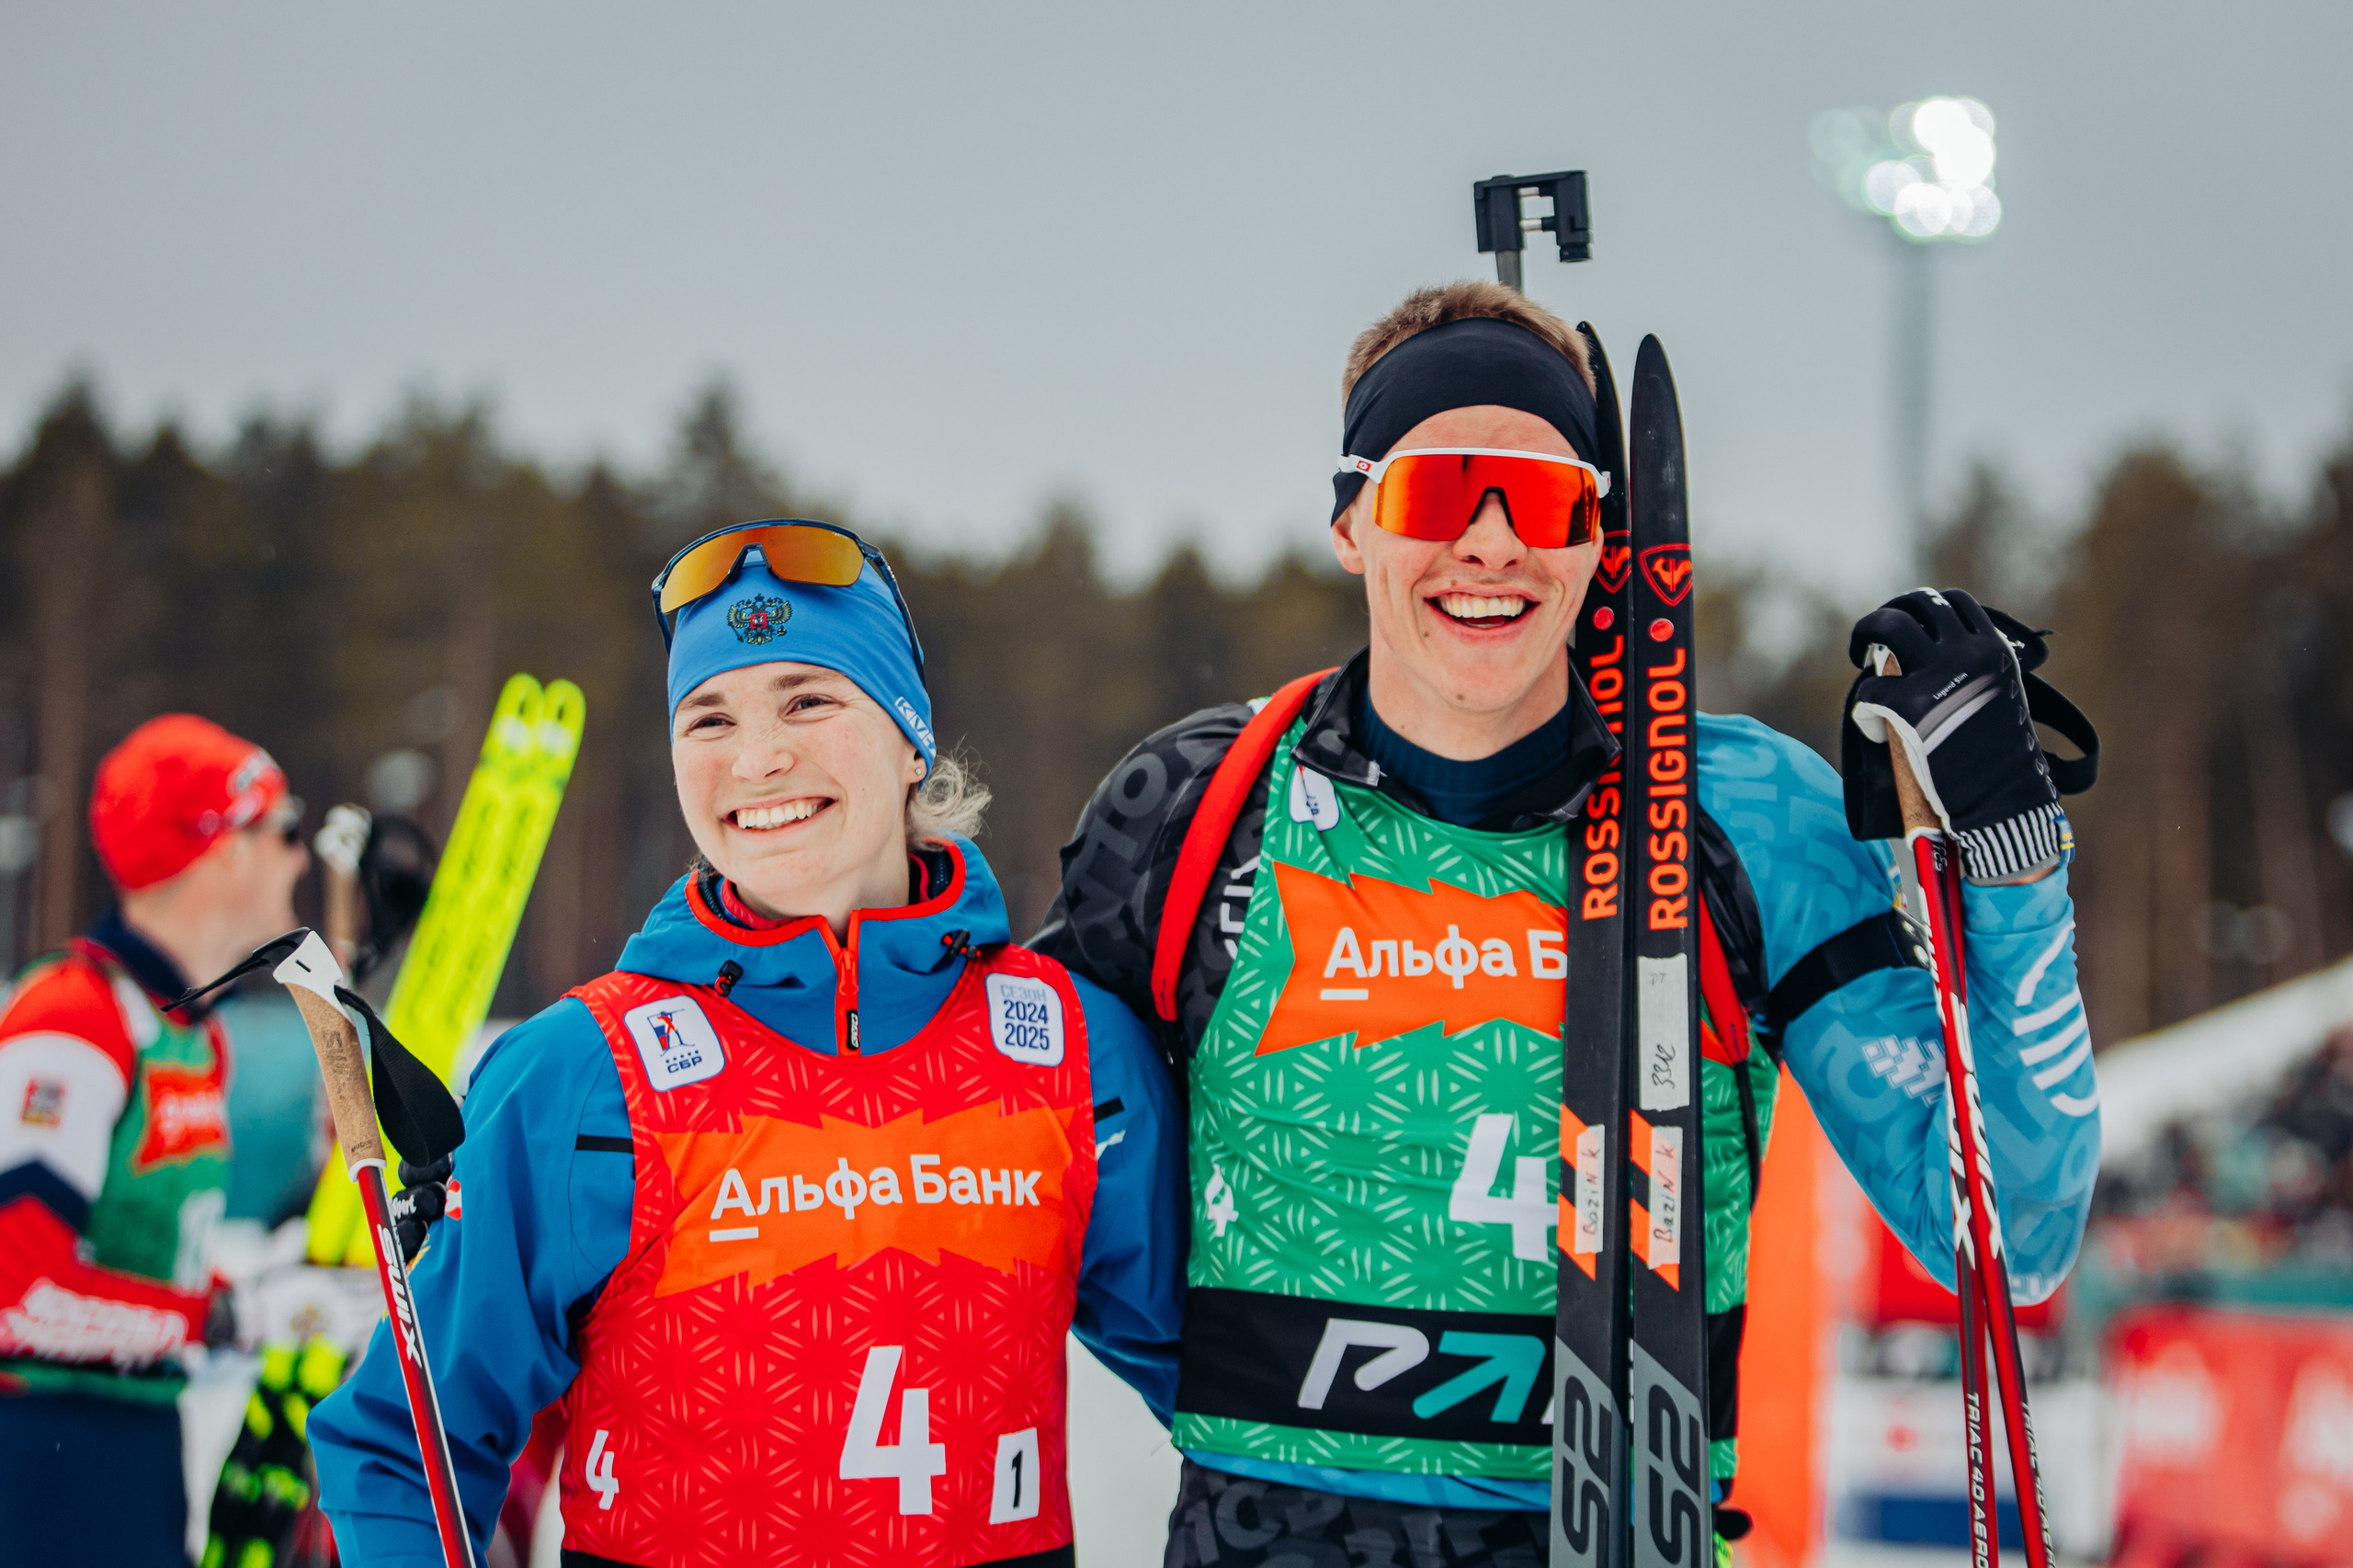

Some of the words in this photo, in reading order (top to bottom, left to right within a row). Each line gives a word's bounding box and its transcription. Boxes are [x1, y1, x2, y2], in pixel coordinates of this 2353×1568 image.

[1932, 680, 1957, 700] Legend
[1953, 672, 1969, 685] Slim
[1582, 634, 1625, 921] ROSSINOL
[1646, 647, 1688, 931] ROSSIGNOL
[1323, 924, 1518, 990] Альфа
[999, 983, 1048, 1003] СЕЗОН
[1003, 998, 1050, 1025] 2024
[666, 1055, 703, 1074] СБР
[1004, 1022, 1051, 1051] 2025
[1949, 990, 2006, 1262] SWIX
[710, 1156, 904, 1221] Альфа
[909, 1153, 1043, 1207] Банк
[1448, 1112, 1561, 1262] 4
[376, 1222, 424, 1369] SWIX
[839, 1345, 947, 1516] 4
[1966, 1392, 1984, 1465] TRIAC
[585, 1429, 620, 1511] 4
[1011, 1449, 1023, 1509] 1
[2039, 1508, 2056, 1568] AER
